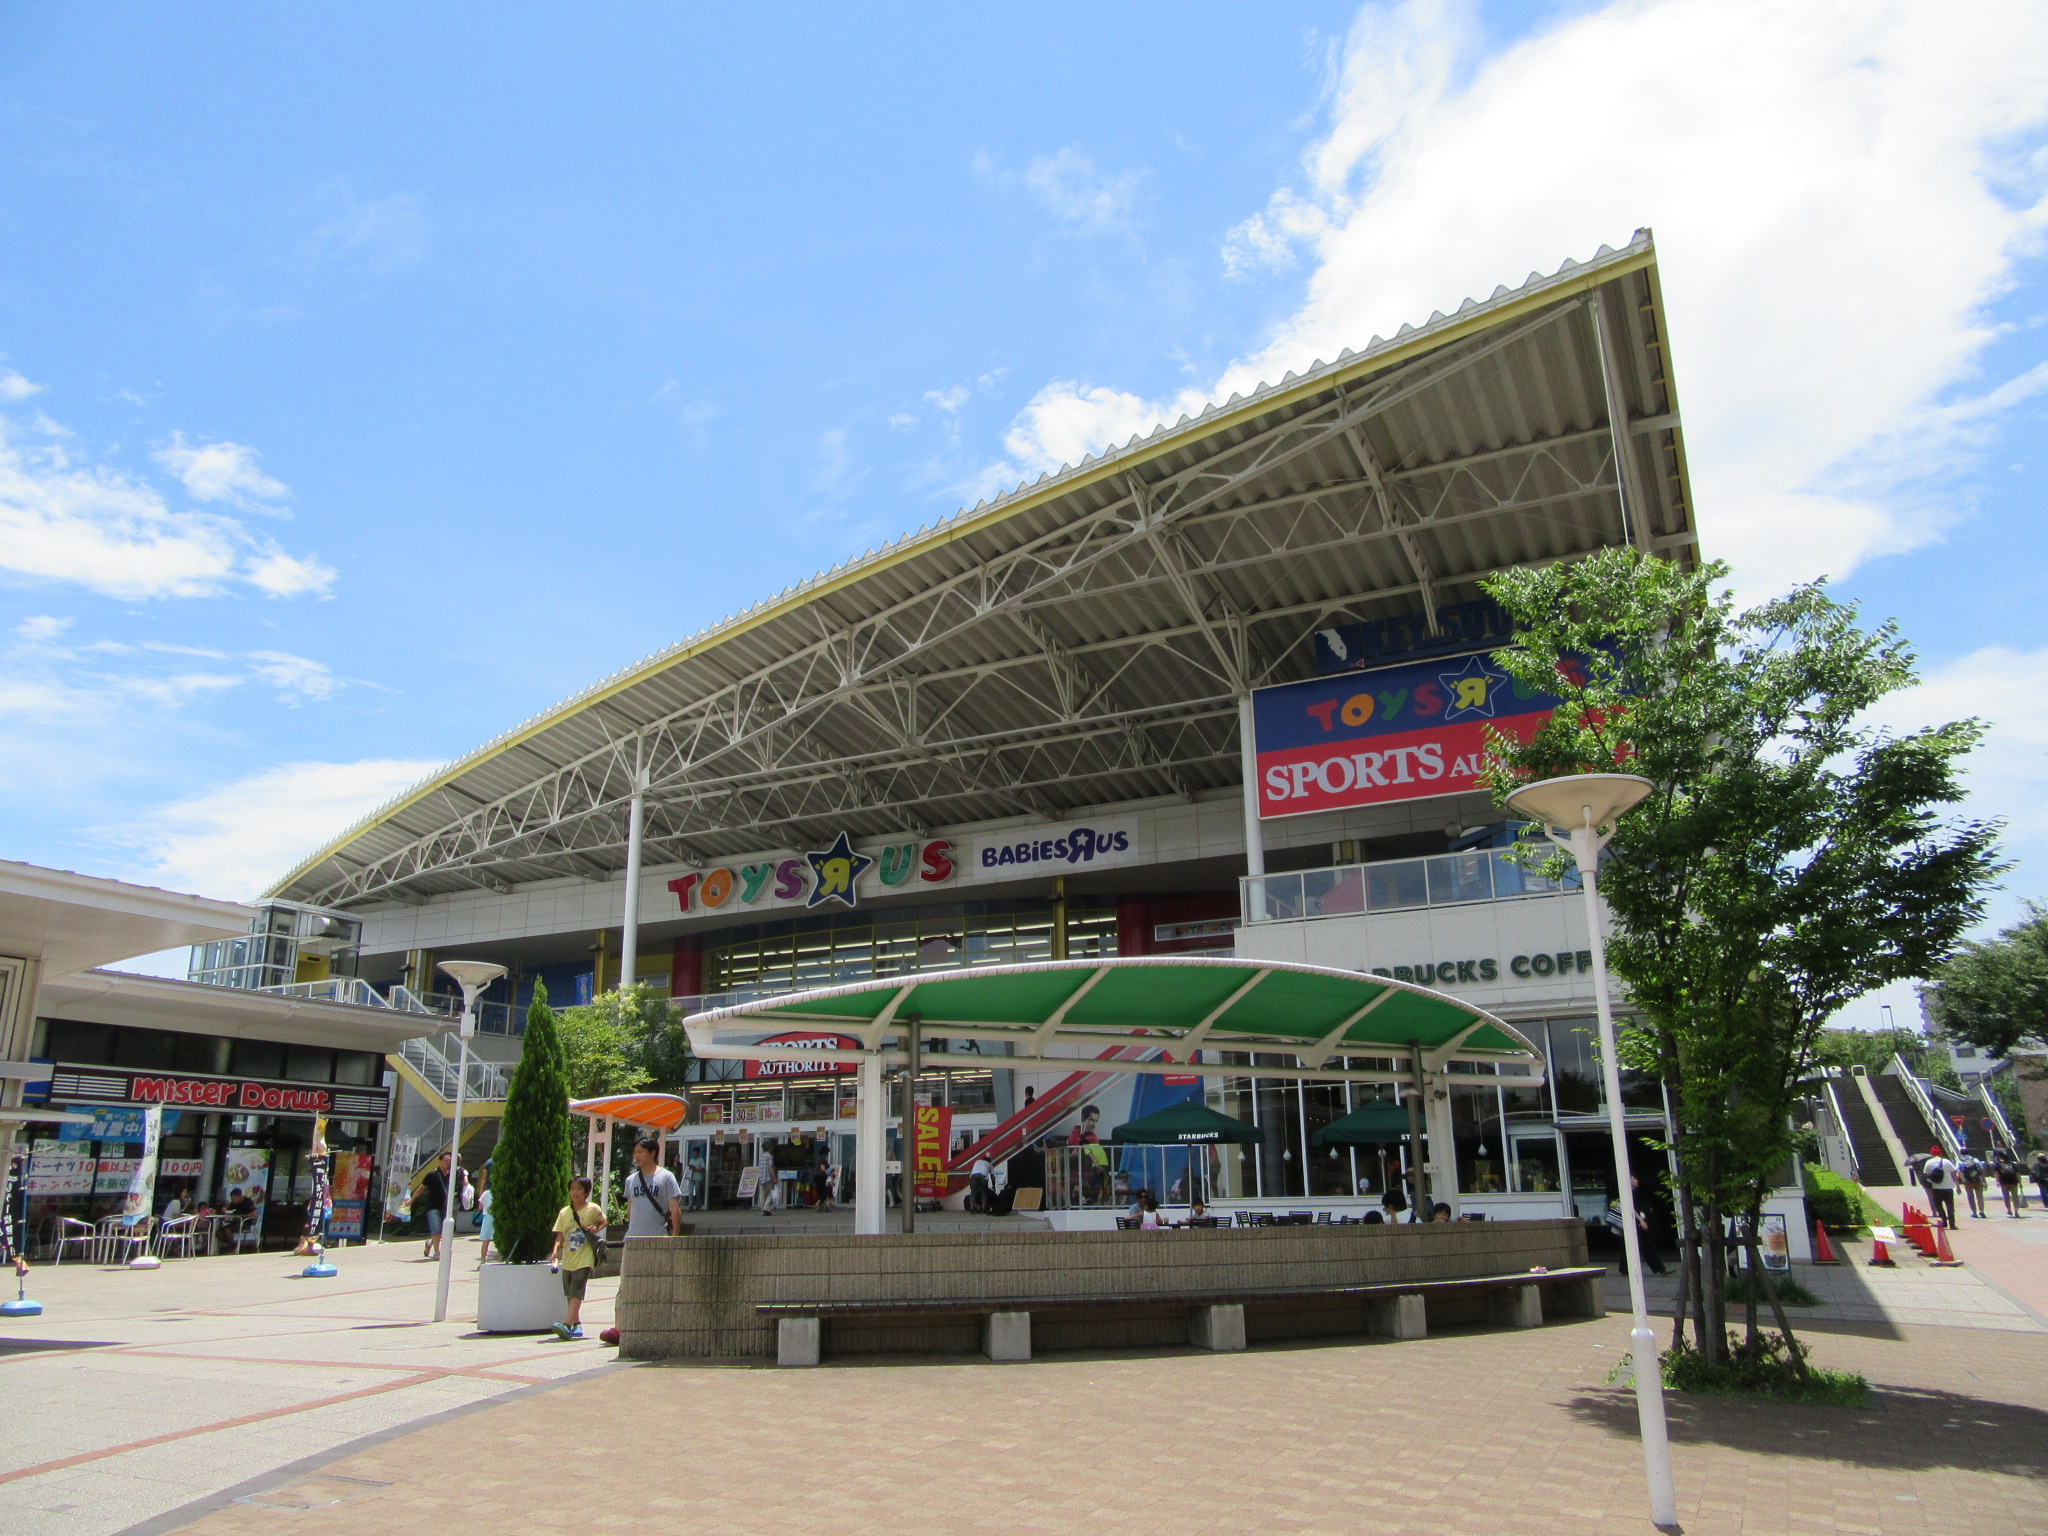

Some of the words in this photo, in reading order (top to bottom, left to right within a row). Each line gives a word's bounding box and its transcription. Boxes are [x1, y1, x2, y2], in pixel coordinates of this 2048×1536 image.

[1307, 683, 1443, 732] TOYS
[1266, 743, 1445, 801] SPORTS
[667, 859, 804, 913] TOYS
[880, 840, 954, 887] US
[1510, 949, 1593, 978] COFF
[758, 1061, 838, 1075] AUTHORITY
[131, 1077, 236, 1105] Mister
[240, 1083, 331, 1111] Donut
[917, 1107, 942, 1172] SALE
[1178, 1132, 1219, 1140] STARBUCKS
